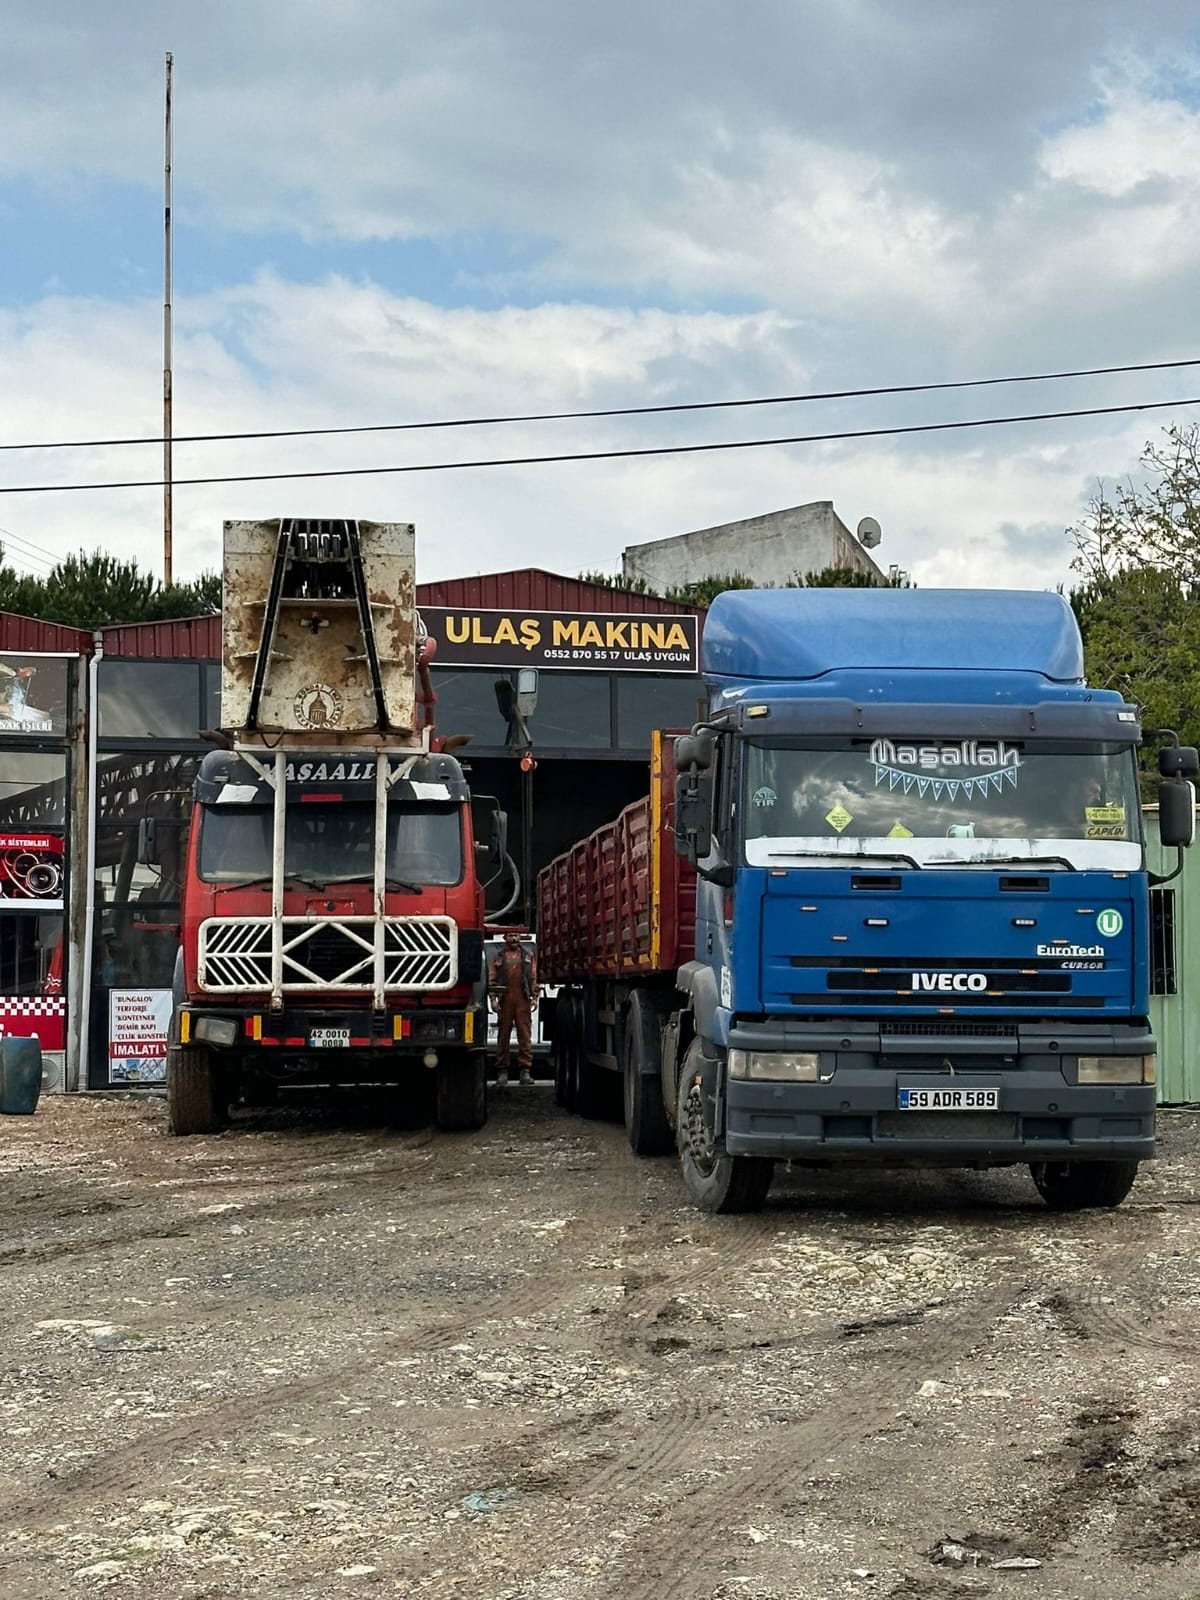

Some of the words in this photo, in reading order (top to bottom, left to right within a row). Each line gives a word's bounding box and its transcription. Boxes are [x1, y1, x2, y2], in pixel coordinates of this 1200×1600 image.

[446, 616, 541, 651] ULAŞ
[552, 620, 690, 649] MAKİNA
[544, 649, 570, 659] 0552
[572, 650, 592, 659] 870
[594, 650, 607, 660] 55
[609, 651, 620, 660] 17
[624, 651, 652, 662] ULAŞ
[654, 652, 690, 662] UYGUN
[1102, 914, 1118, 933] U
[1037, 944, 1104, 957] EuroTech
[1060, 961, 1104, 969] CURSOR
[912, 973, 987, 991] IVECO
[310, 1030, 324, 1039] 42
[326, 1030, 348, 1039] 0010
[114, 1043, 160, 1055] İMALATI
[909, 1091, 928, 1107] 59
[933, 1091, 962, 1107] ADR
[966, 1091, 996, 1107] 589
